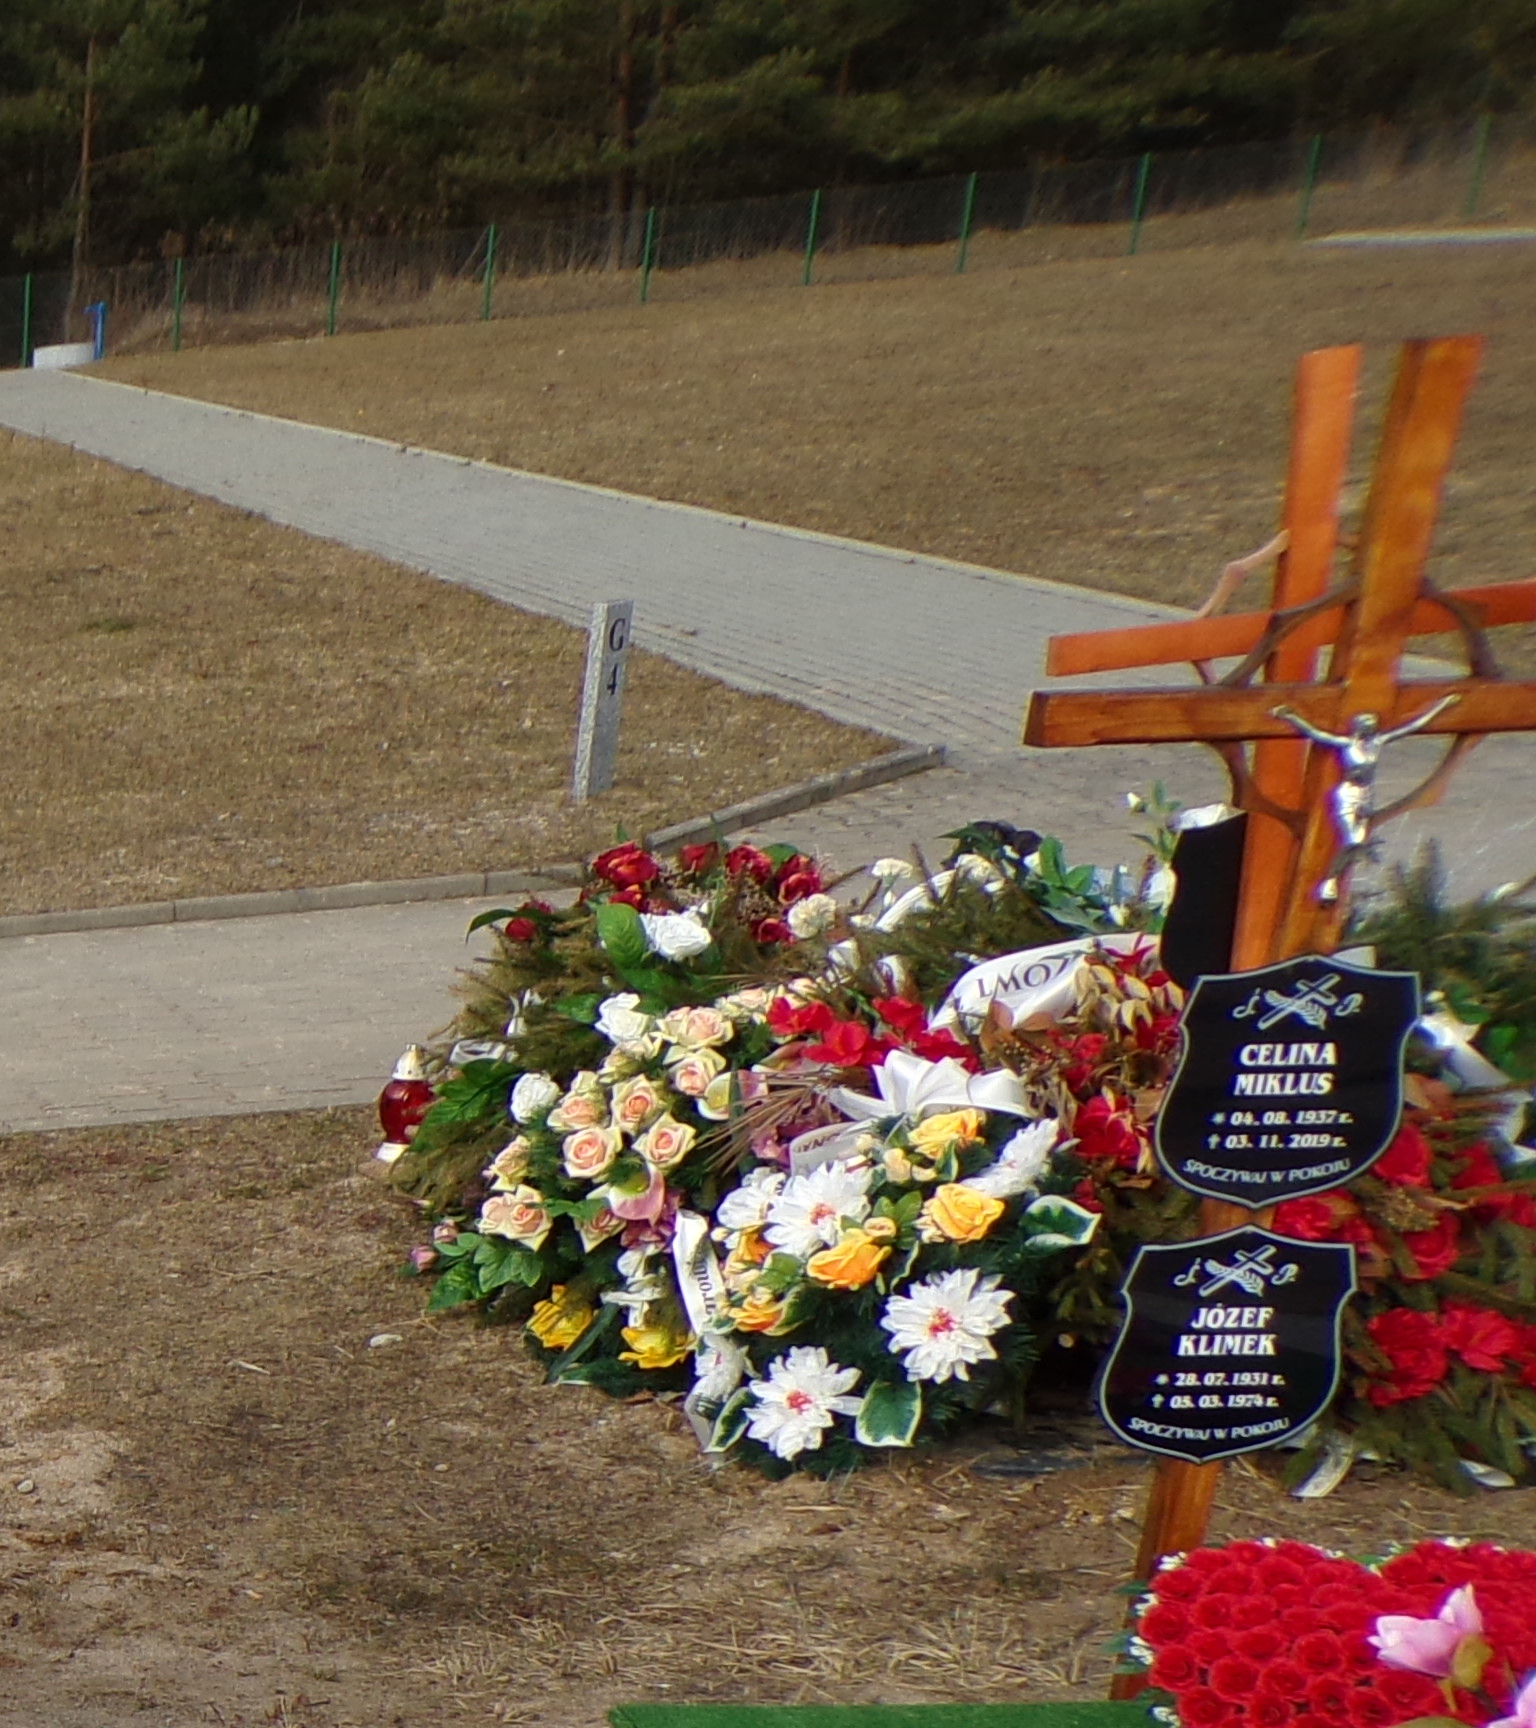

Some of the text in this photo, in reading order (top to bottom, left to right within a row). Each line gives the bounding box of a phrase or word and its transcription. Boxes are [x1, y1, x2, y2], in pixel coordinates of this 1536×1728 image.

[1239, 1042, 1337, 1066] CELINA
[1234, 1072, 1335, 1096] MIKLUS
[1183, 1158, 1351, 1184] SPOCZYWAJ W POKOJU
[1190, 1303, 1275, 1328] JÓZEF
[1177, 1334, 1277, 1356] KLIMEK
[1214, 1427, 1228, 1440] W
[1231, 1416, 1290, 1440] POKOJU
